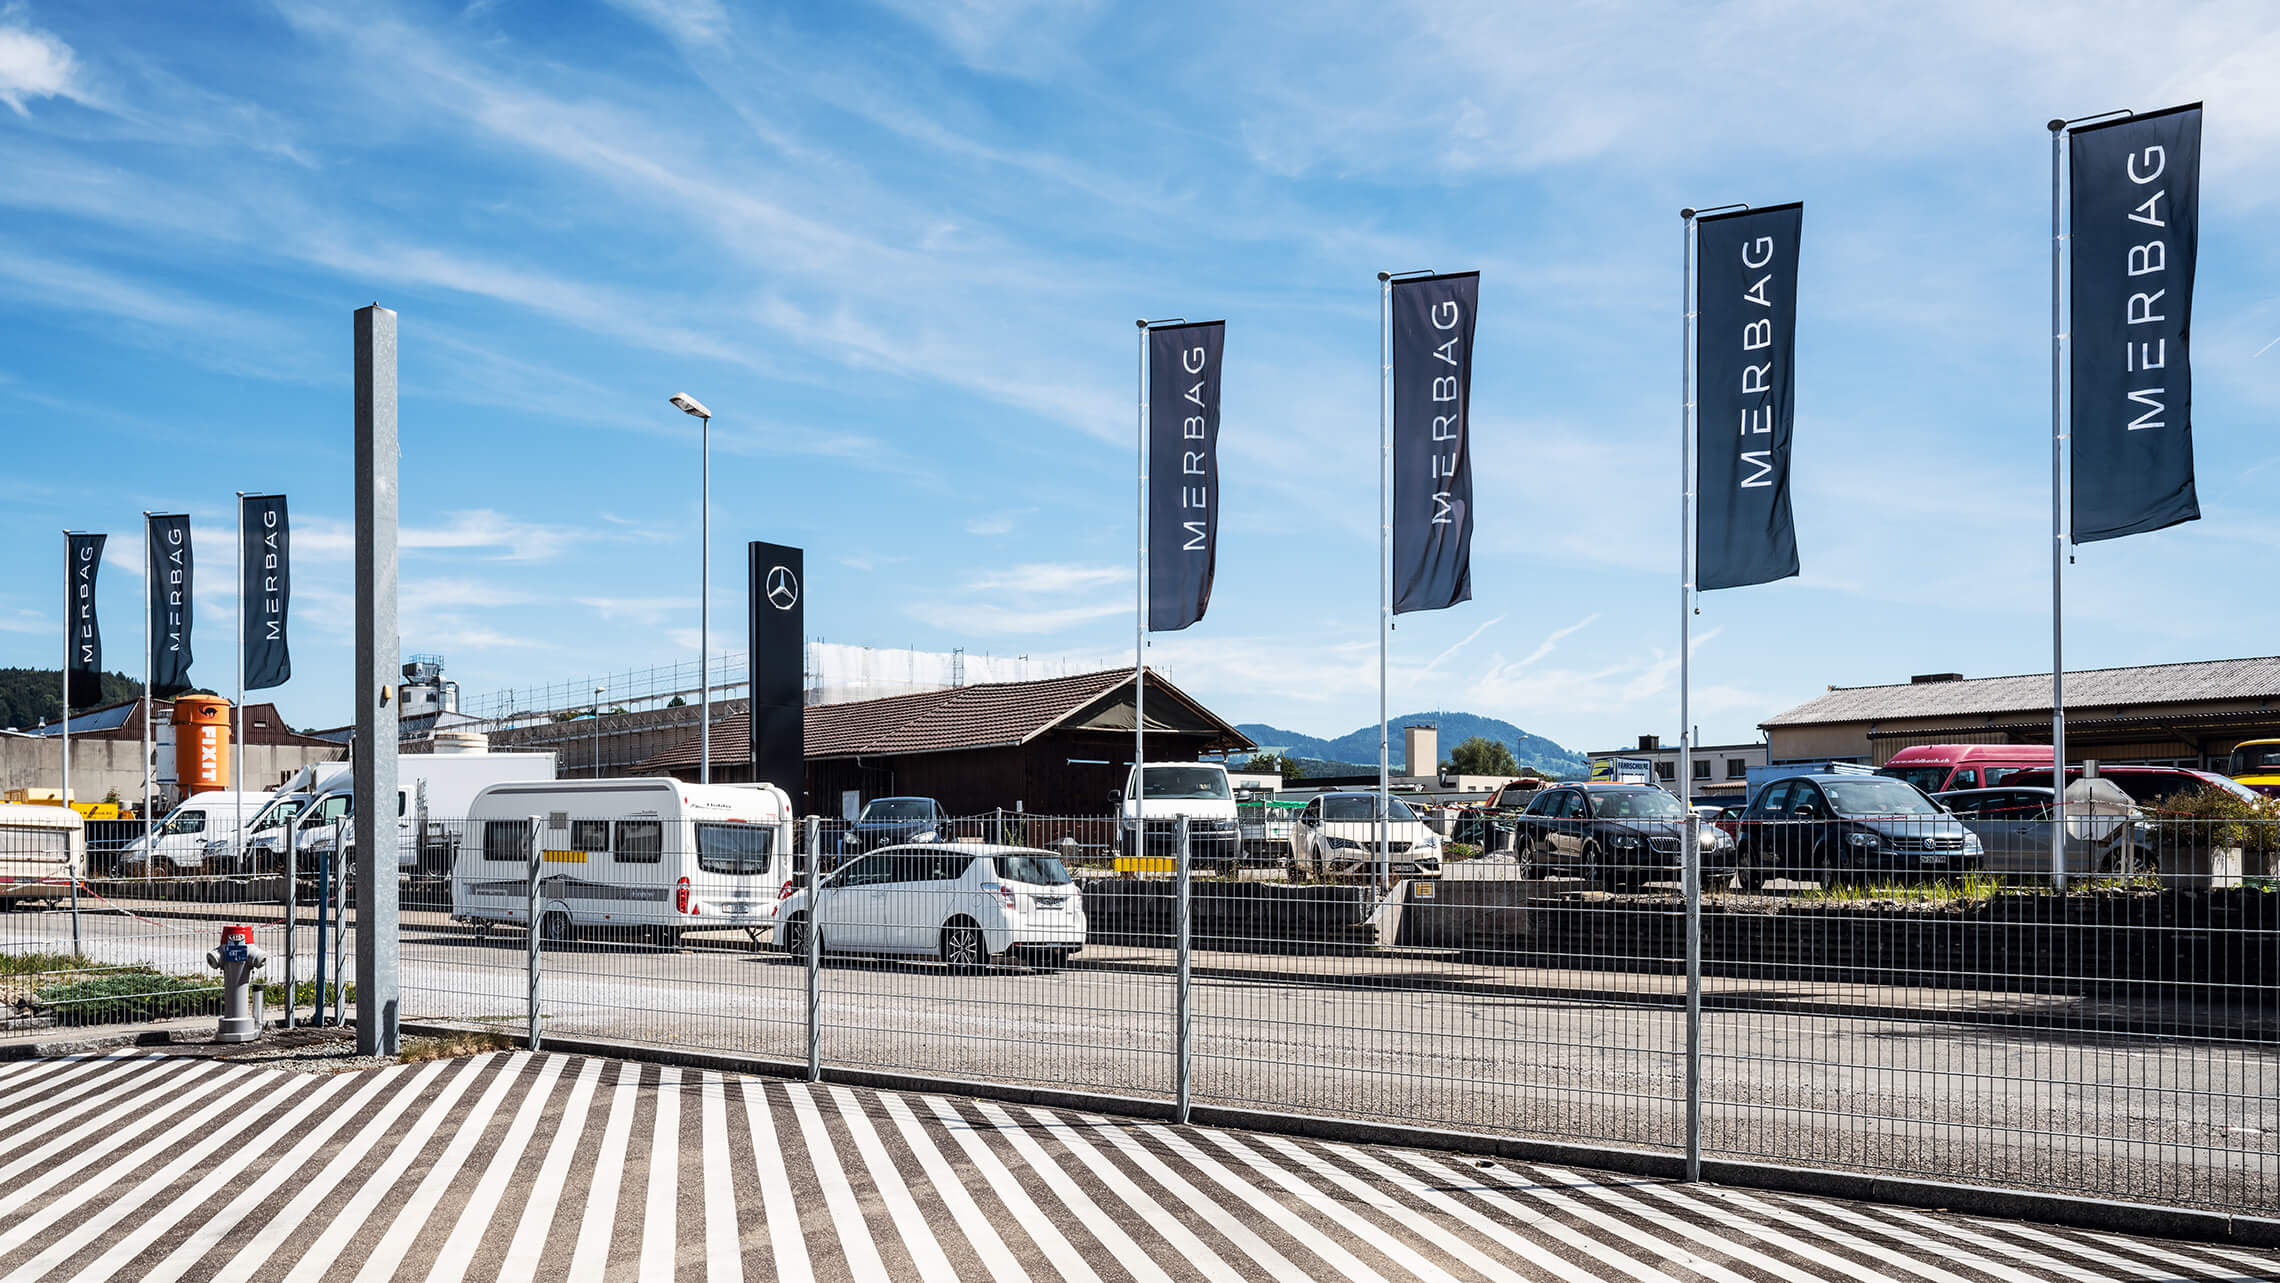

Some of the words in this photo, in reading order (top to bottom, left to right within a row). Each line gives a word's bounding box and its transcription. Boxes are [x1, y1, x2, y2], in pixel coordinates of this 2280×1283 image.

[1741, 236, 1774, 489] MERBAG
[2127, 145, 2166, 431] MERBAG
[1183, 346, 1206, 551] MERBAG
[1431, 300, 1460, 525] MERBAG
[80, 546, 93, 663] MERBAG
[168, 528, 183, 651] MERBAG
[264, 510, 280, 640] MERBAG
[201, 726, 217, 782] FIXIT
